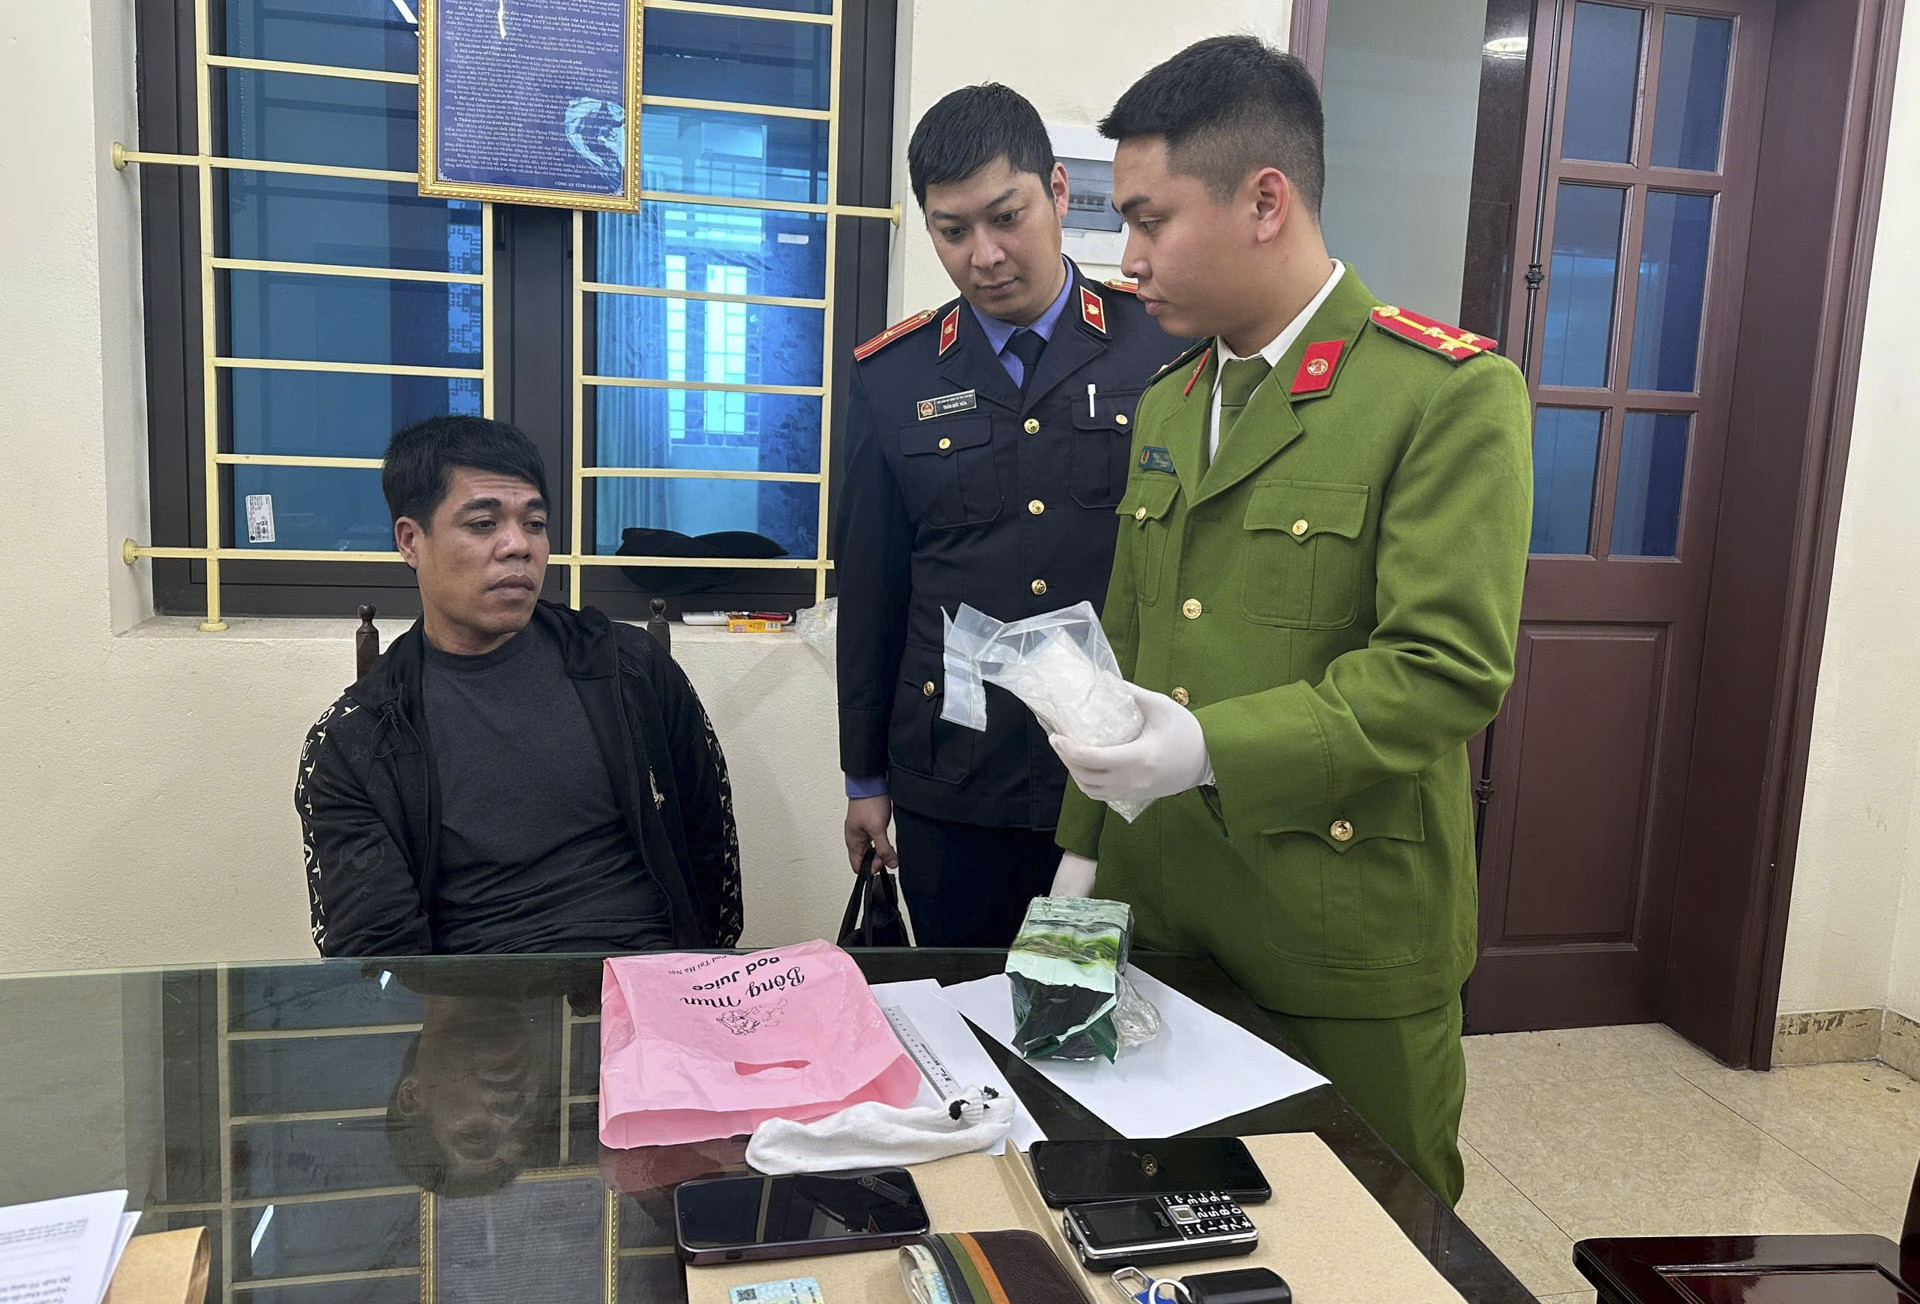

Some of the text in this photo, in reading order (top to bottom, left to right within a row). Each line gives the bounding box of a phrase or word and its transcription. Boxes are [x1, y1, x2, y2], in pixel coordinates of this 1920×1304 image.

[680, 966, 805, 1009] Bông Mun
[691, 970, 741, 991] Juice
